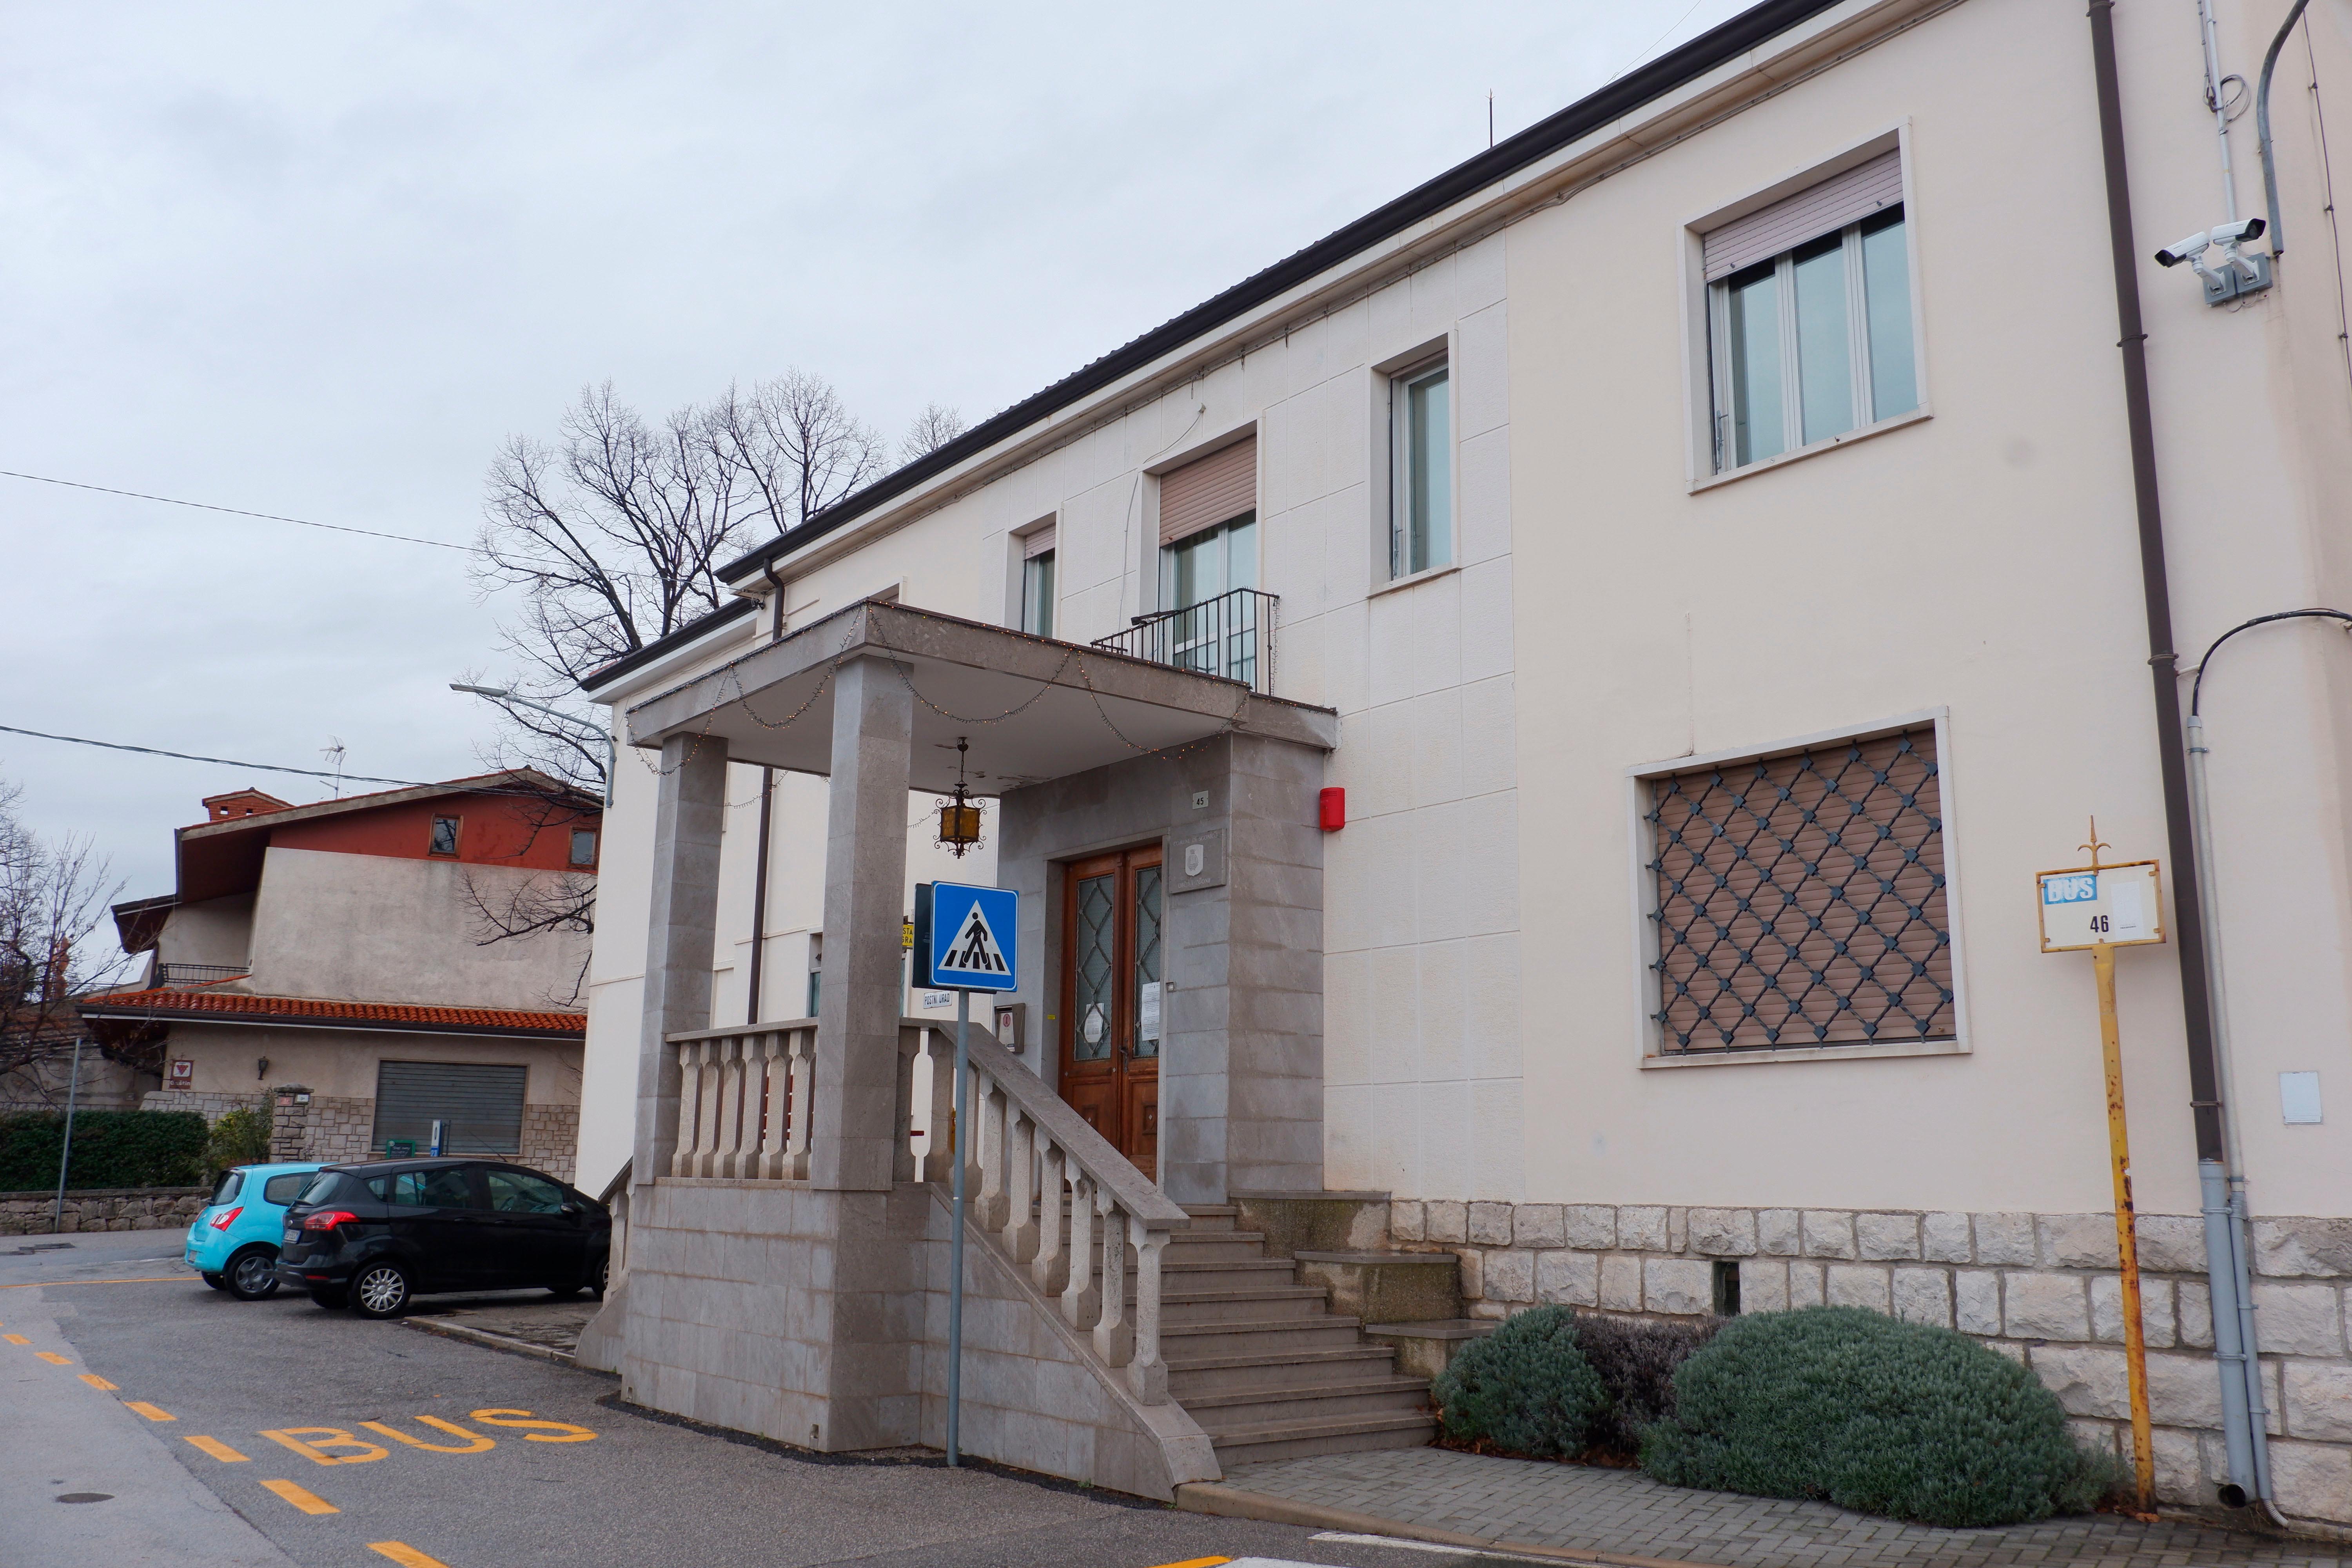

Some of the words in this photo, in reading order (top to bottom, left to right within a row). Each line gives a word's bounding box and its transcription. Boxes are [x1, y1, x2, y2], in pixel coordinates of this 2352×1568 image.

[1197, 797, 1204, 806] 45
[2048, 877, 2093, 902] BUS
[2090, 915, 2109, 933] 46
[925, 994, 937, 1005] POŠTNI
[258, 1408, 599, 1466] BUS
